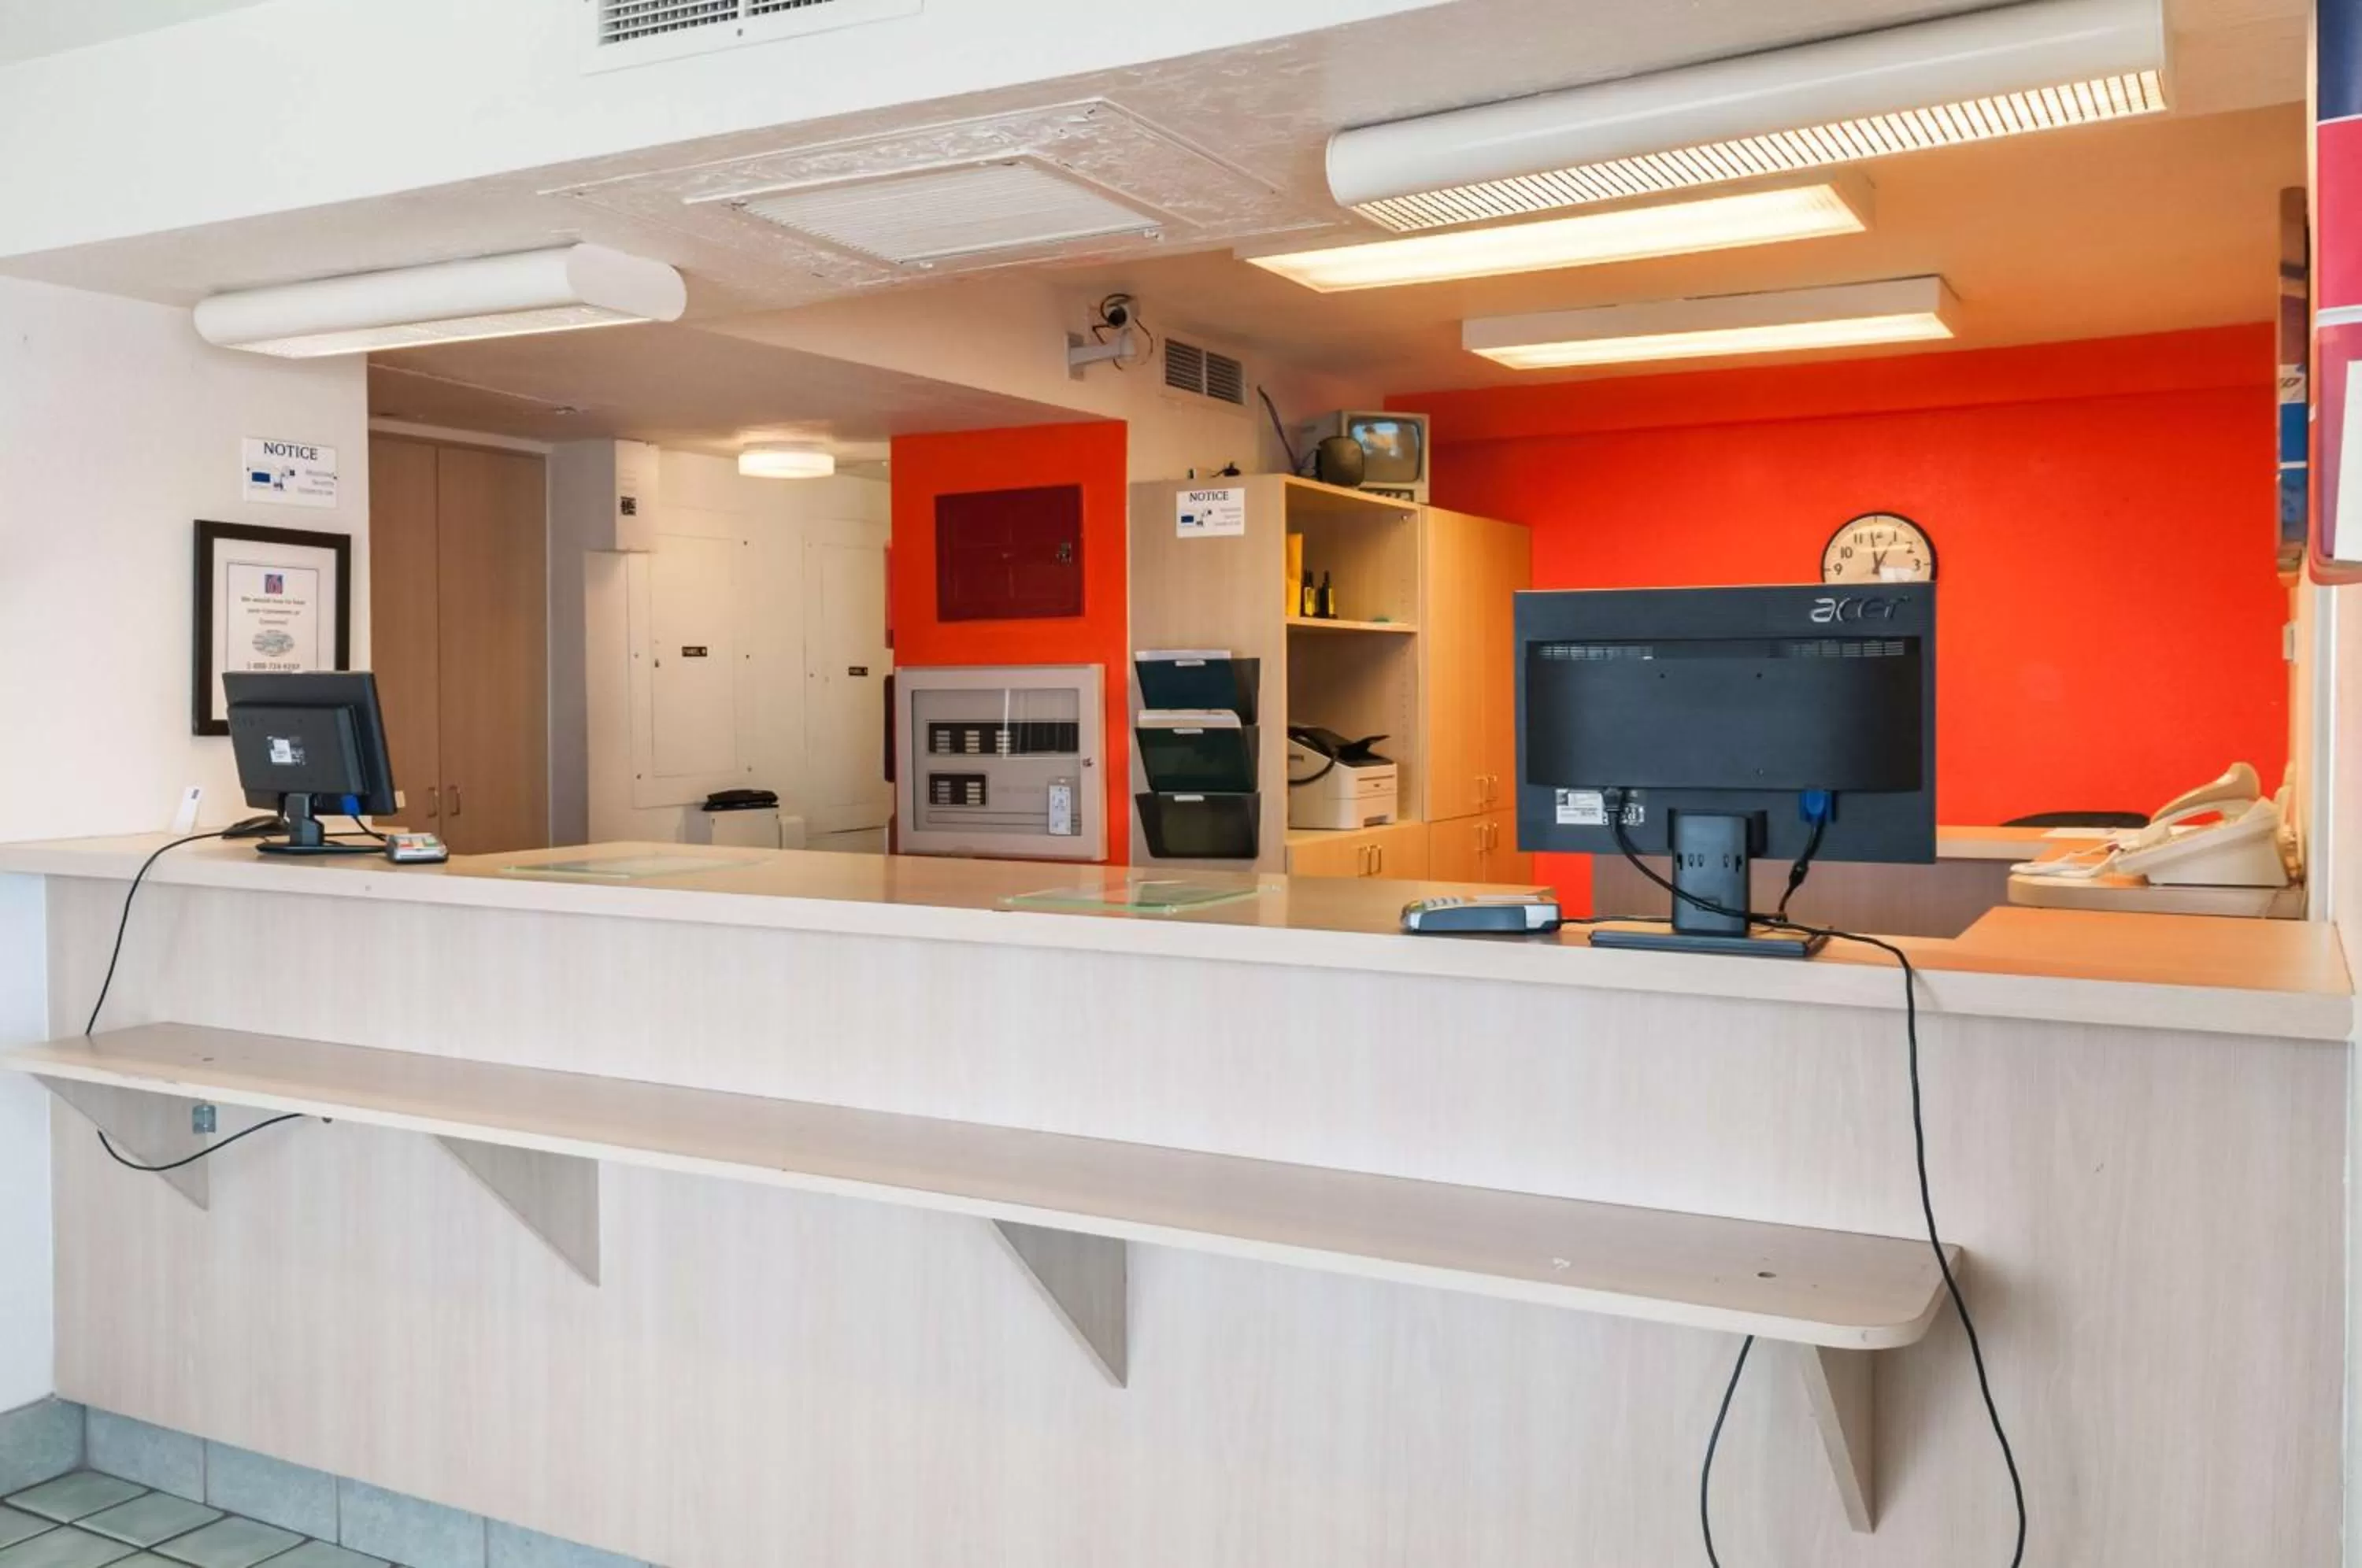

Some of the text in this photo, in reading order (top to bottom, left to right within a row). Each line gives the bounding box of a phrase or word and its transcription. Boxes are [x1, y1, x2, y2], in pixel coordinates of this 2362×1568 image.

[264, 442, 319, 460] NOTICE
[1190, 491, 1229, 502] NOTICE
[1854, 533, 1863, 543] 11
[1841, 546, 1853, 558] 10
[1834, 563, 1842, 575] 9
[1811, 597, 1911, 623] acer
